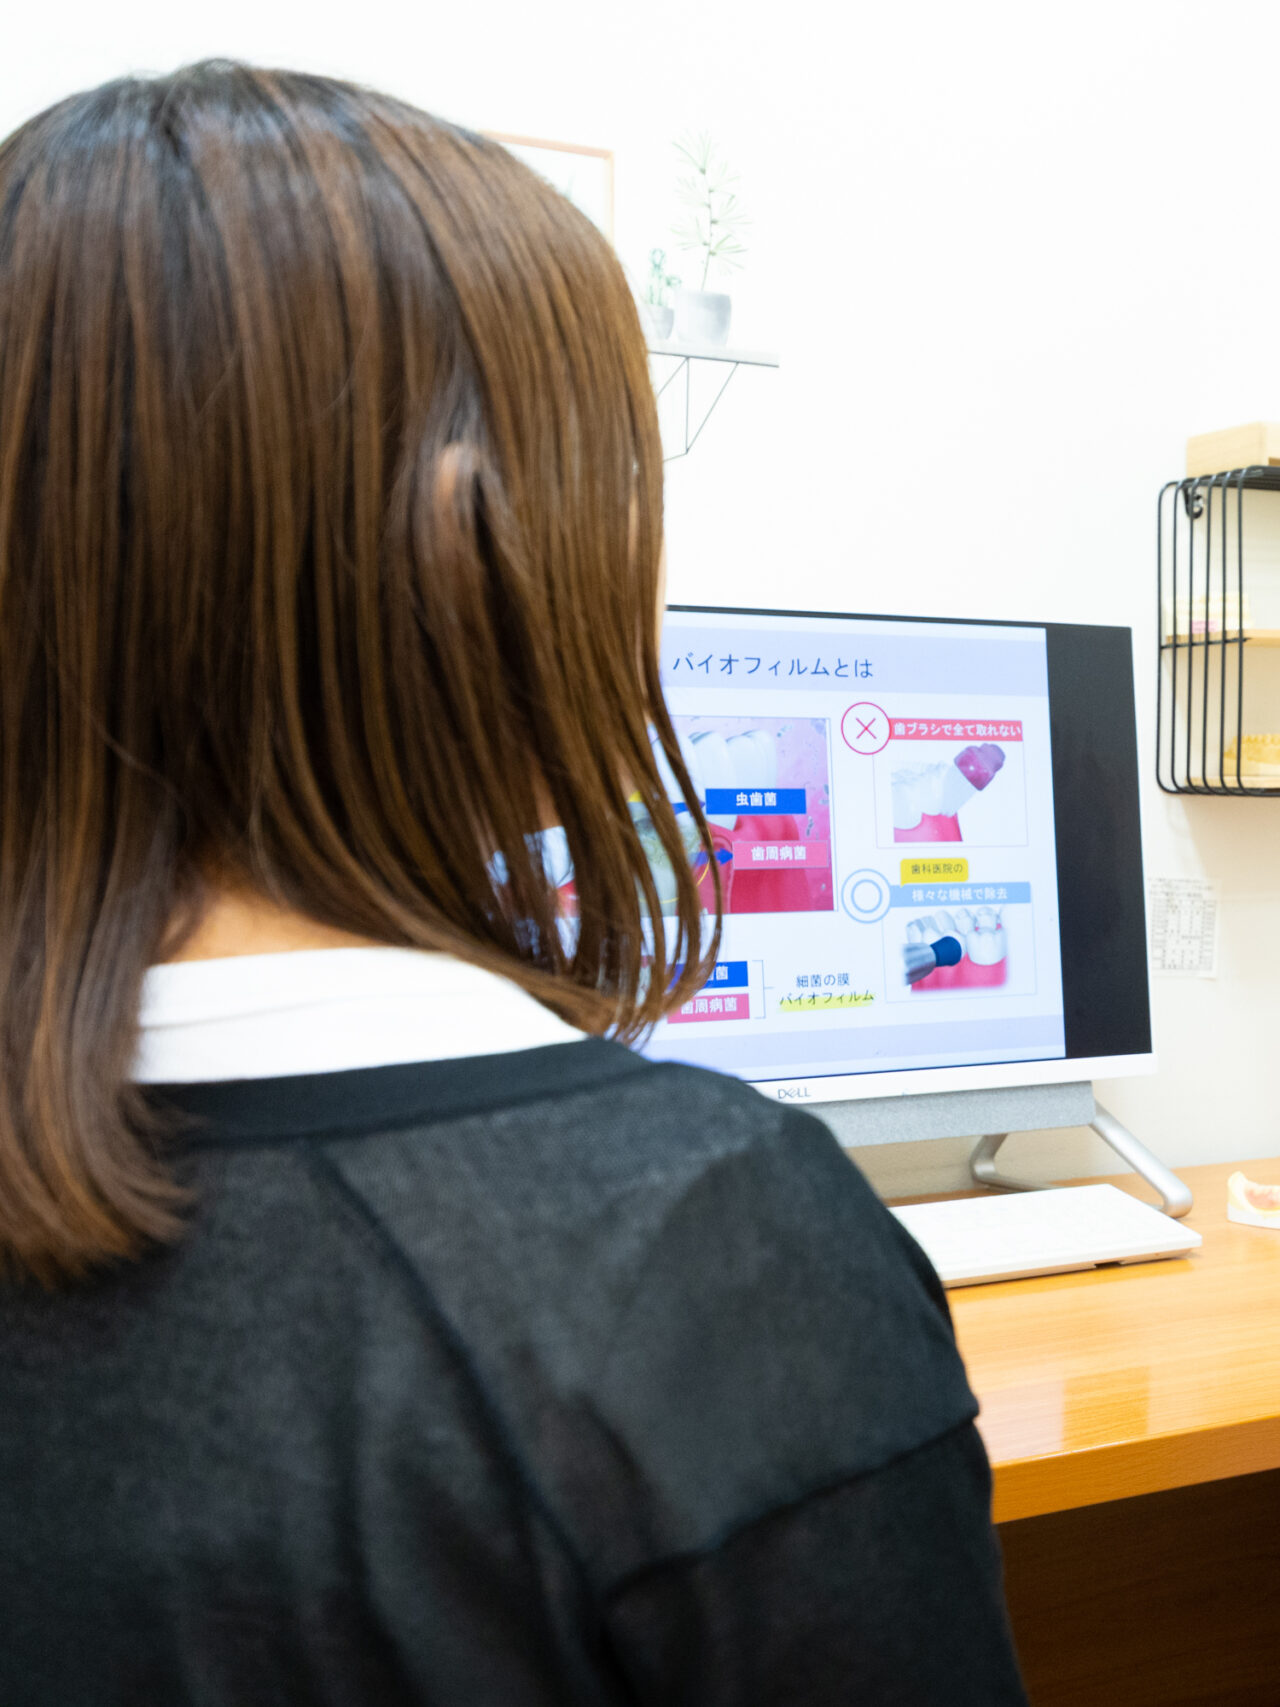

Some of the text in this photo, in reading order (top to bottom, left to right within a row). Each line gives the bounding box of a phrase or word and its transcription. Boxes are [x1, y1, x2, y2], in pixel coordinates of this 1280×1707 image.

[672, 652, 874, 679] バイオフィルムとは
[893, 722, 1021, 738] 歯ブラシで全て取れない
[736, 791, 777, 807] 虫歯菌
[751, 845, 807, 862] 歯周病菌
[911, 863, 964, 875] 歯科医院の
[911, 887, 1008, 903] 様々な機械で除去
[796, 972, 851, 988] 細菌の膜
[779, 989, 875, 1006] バイオフィルム
[777, 1087, 812, 1100] DELL
